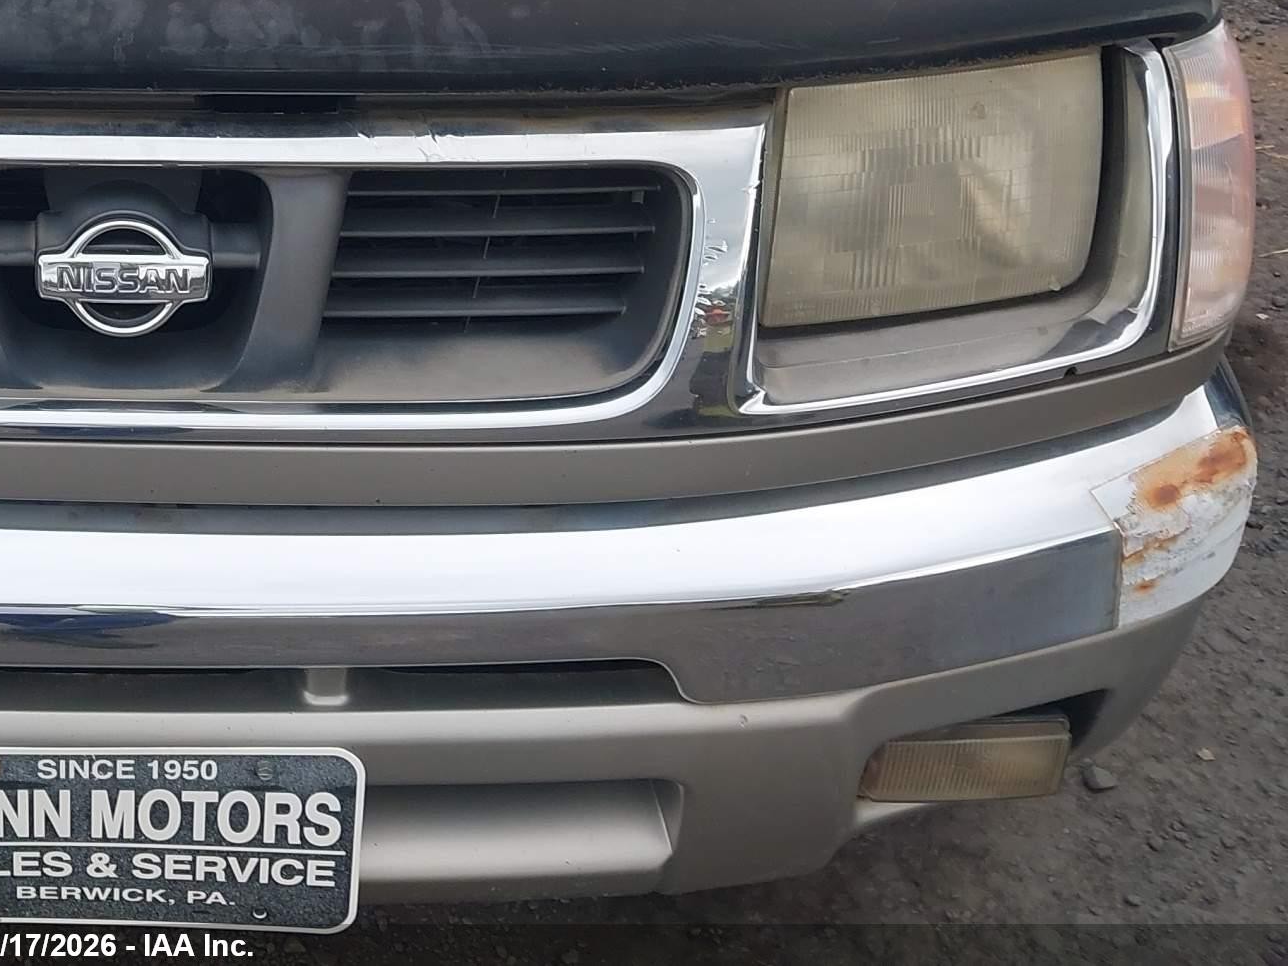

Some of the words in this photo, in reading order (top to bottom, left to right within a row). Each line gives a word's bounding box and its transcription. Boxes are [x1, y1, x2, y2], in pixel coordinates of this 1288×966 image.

[55, 264, 191, 294] NISSAN
[37, 759, 135, 781] SINCE
[147, 759, 218, 781] 1950
[91, 788, 342, 847] MOTORS
[86, 852, 119, 879] &
[132, 853, 336, 887] SERVICE
[16, 886, 175, 906] BERWICK,
[187, 890, 236, 906] PA.
